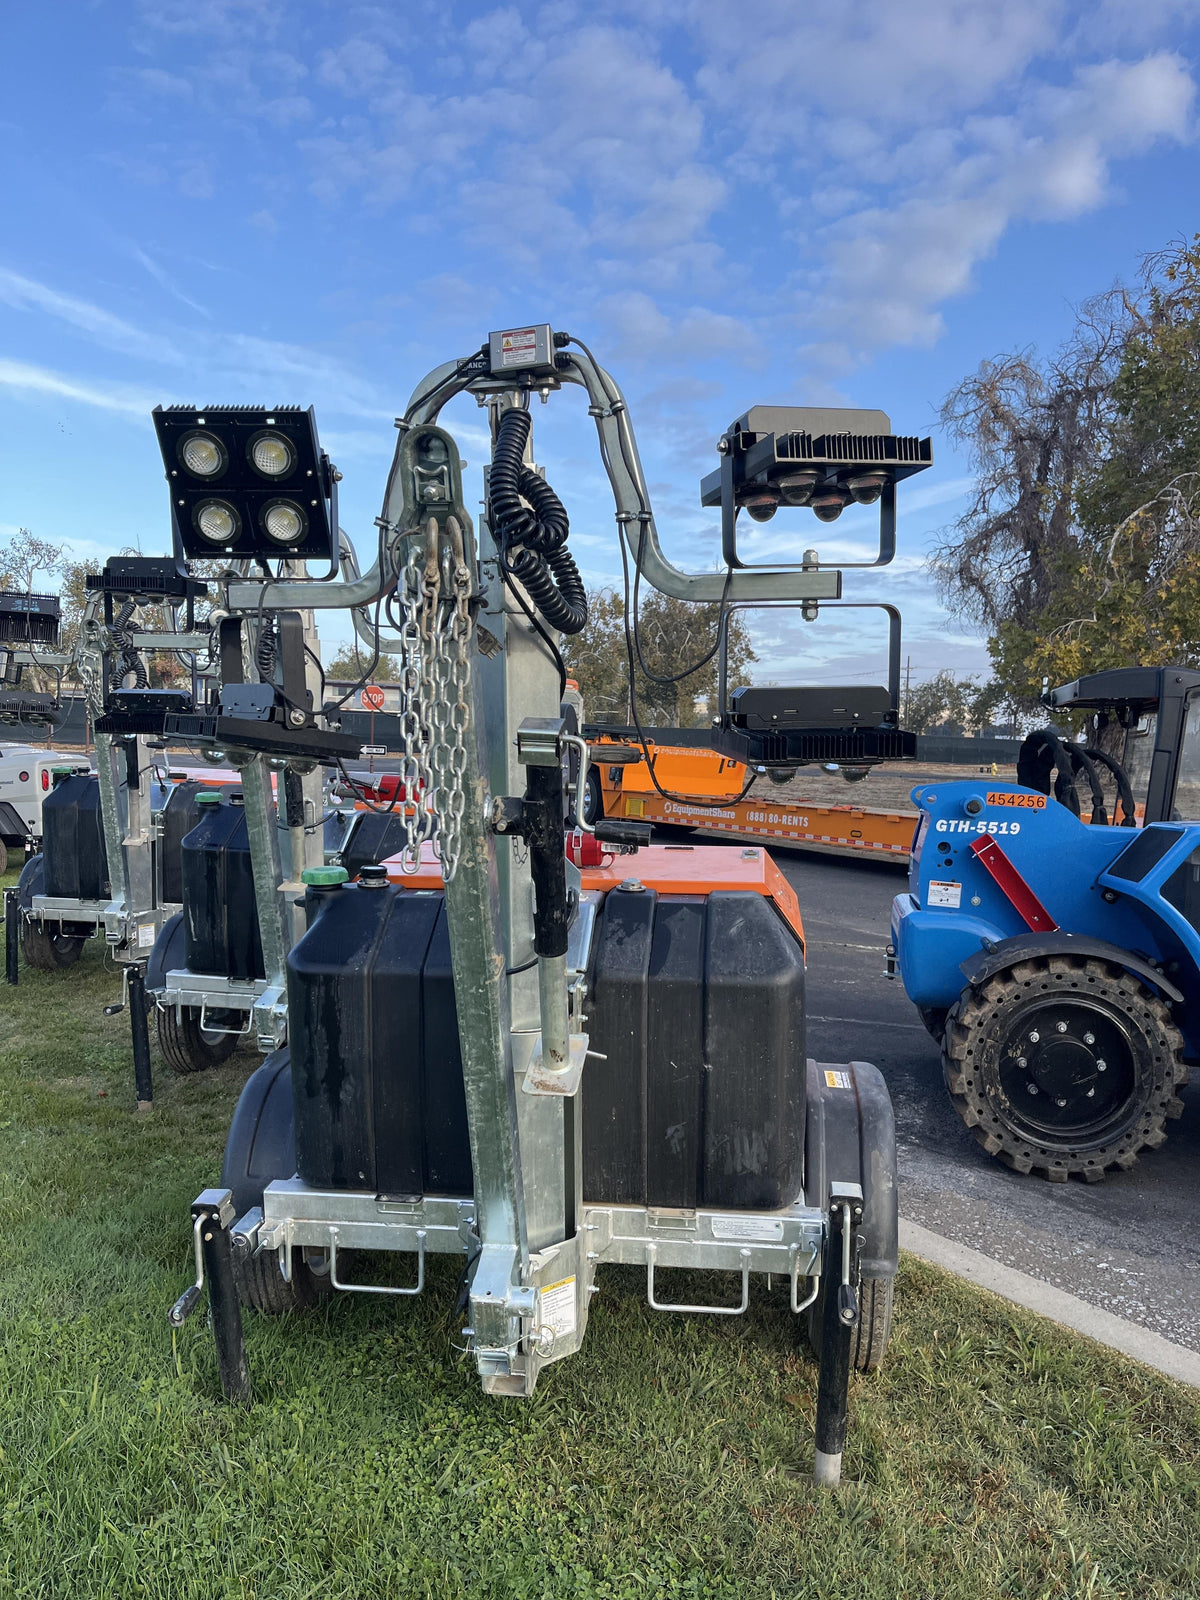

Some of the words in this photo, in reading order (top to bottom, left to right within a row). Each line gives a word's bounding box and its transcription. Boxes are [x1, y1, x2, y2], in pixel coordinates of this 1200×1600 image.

[363, 693, 384, 703] STOP
[987, 793, 1045, 808] 454256
[672, 803, 736, 819] EquipmentShare
[746, 811, 767, 823] (888)
[768, 813, 809, 827] 80-RENTS
[935, 819, 1021, 835] GTH-5519
